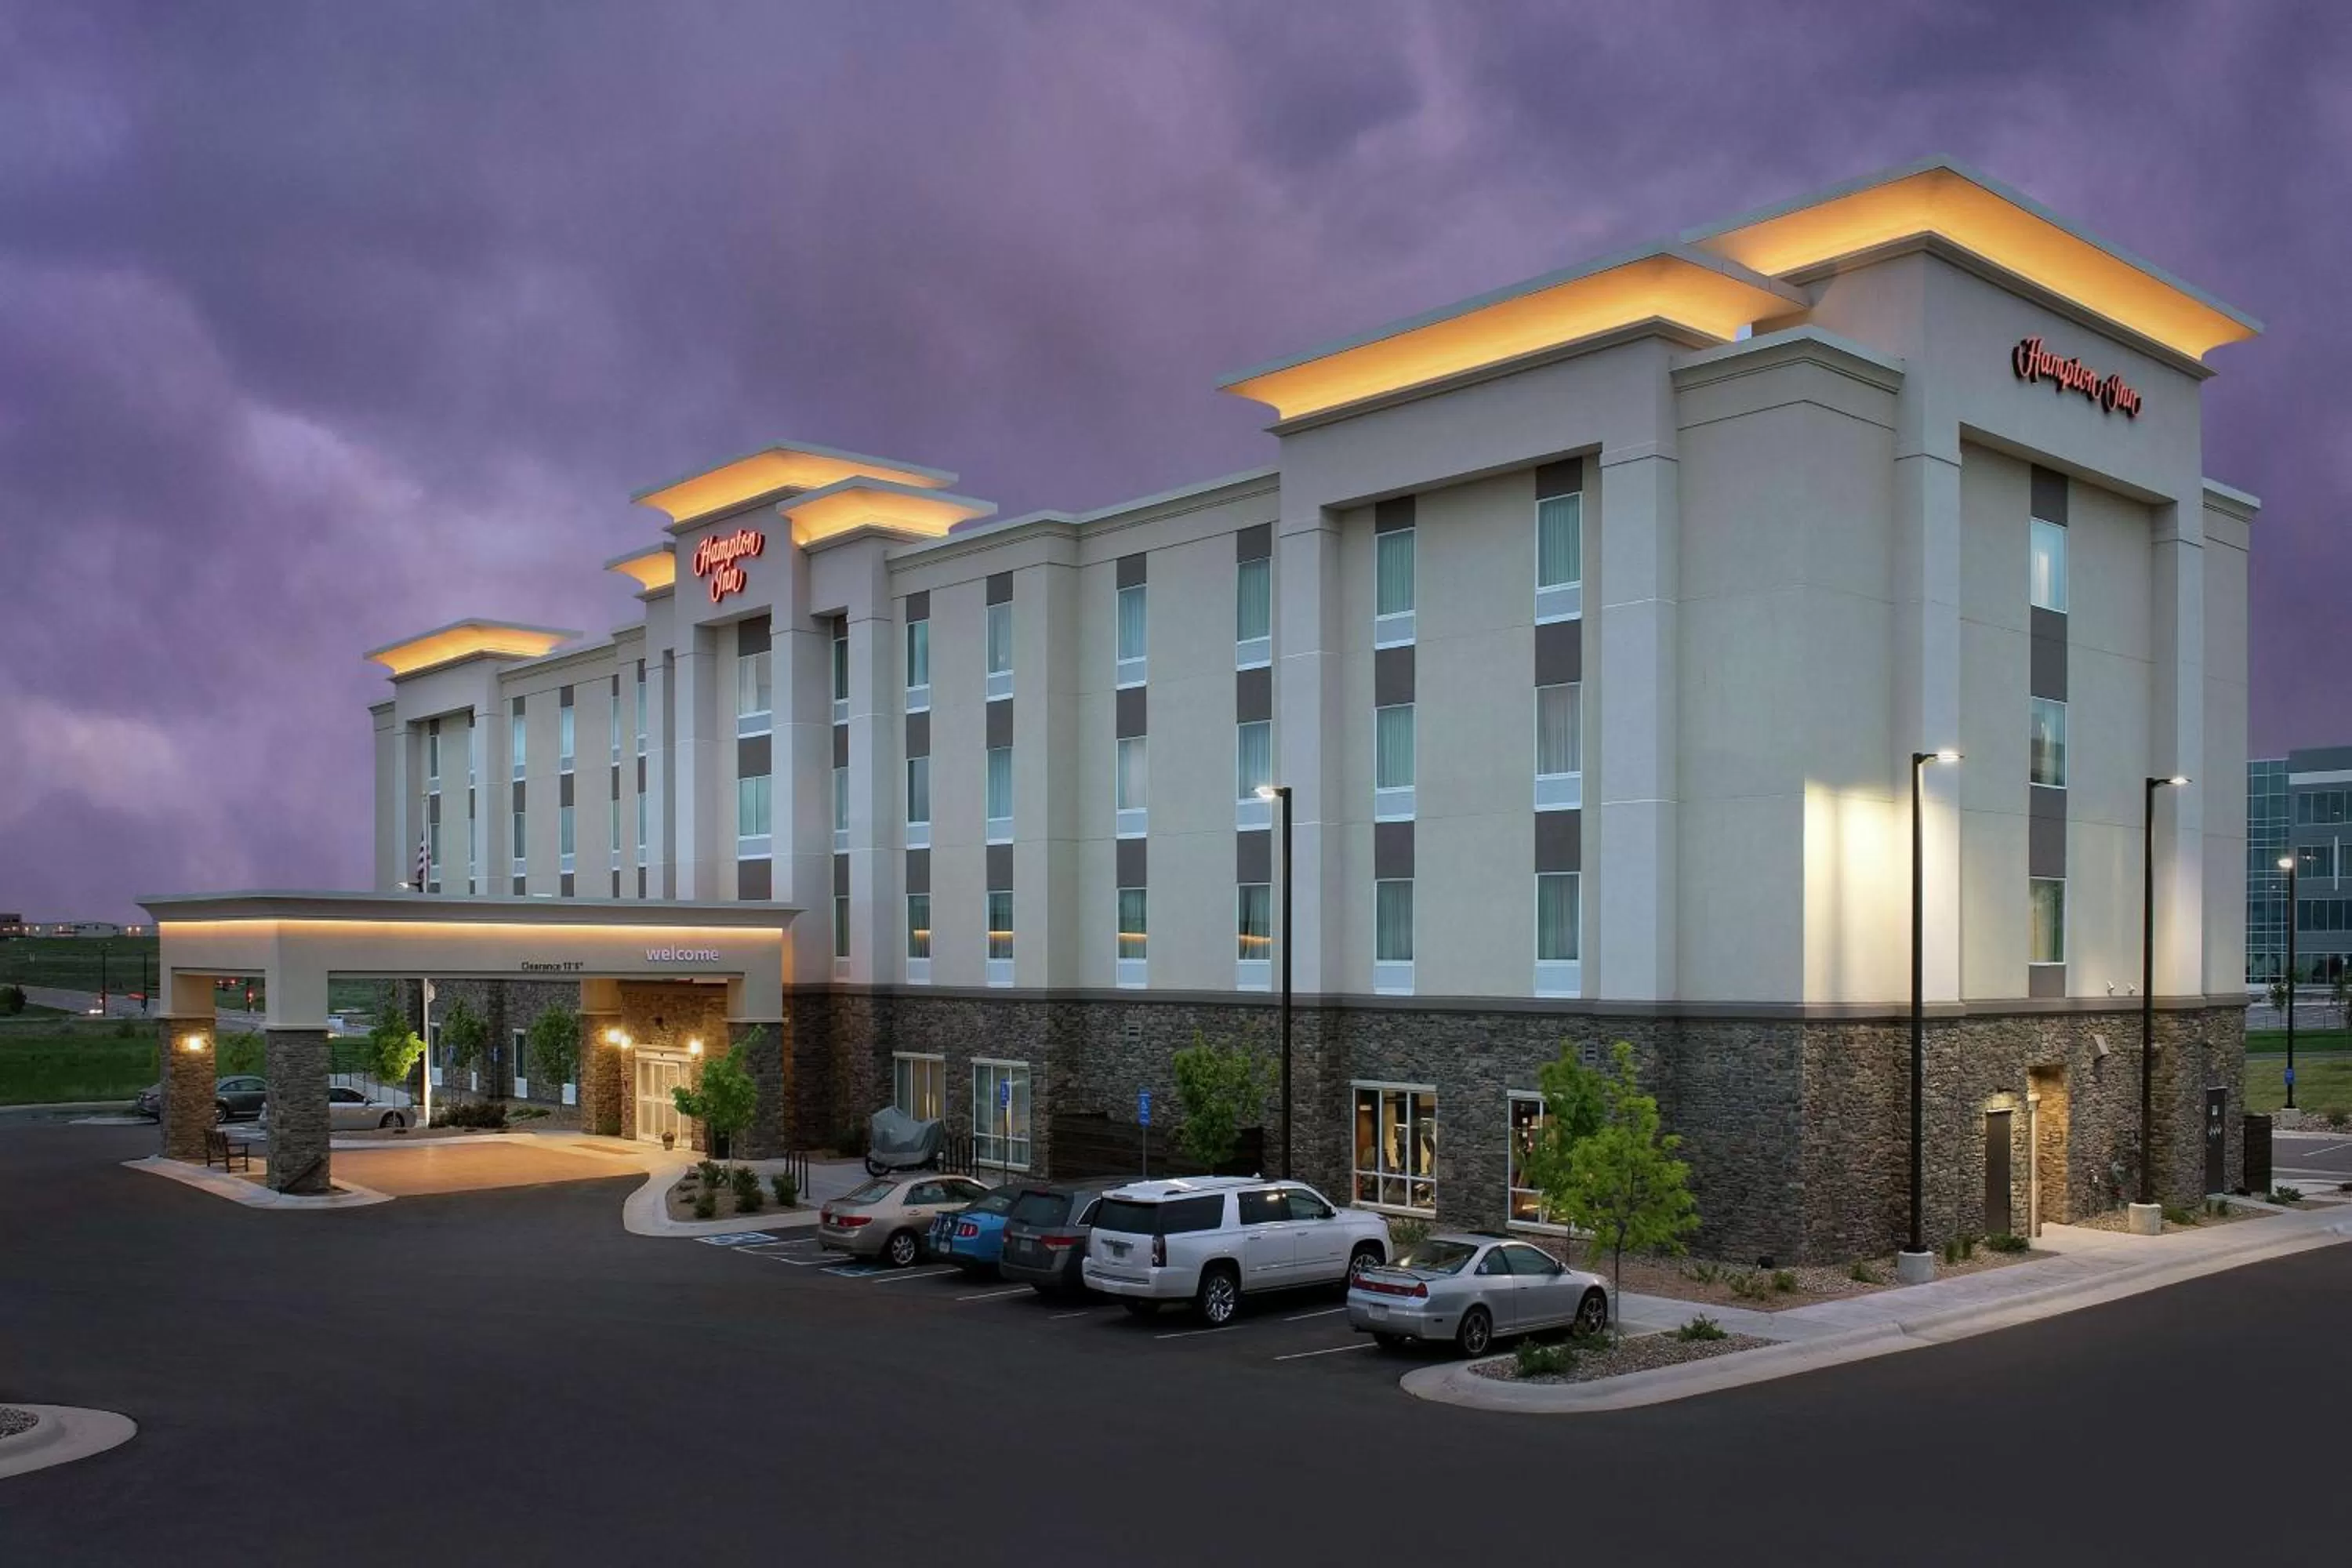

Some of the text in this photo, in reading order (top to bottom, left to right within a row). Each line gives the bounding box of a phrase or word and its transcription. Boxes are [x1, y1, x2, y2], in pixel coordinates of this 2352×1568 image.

[2013, 336, 2142, 417] Hampton Inn
[694, 528, 764, 576] Hampton
[711, 564, 746, 603] Inn
[645, 945, 719, 960] welcome
